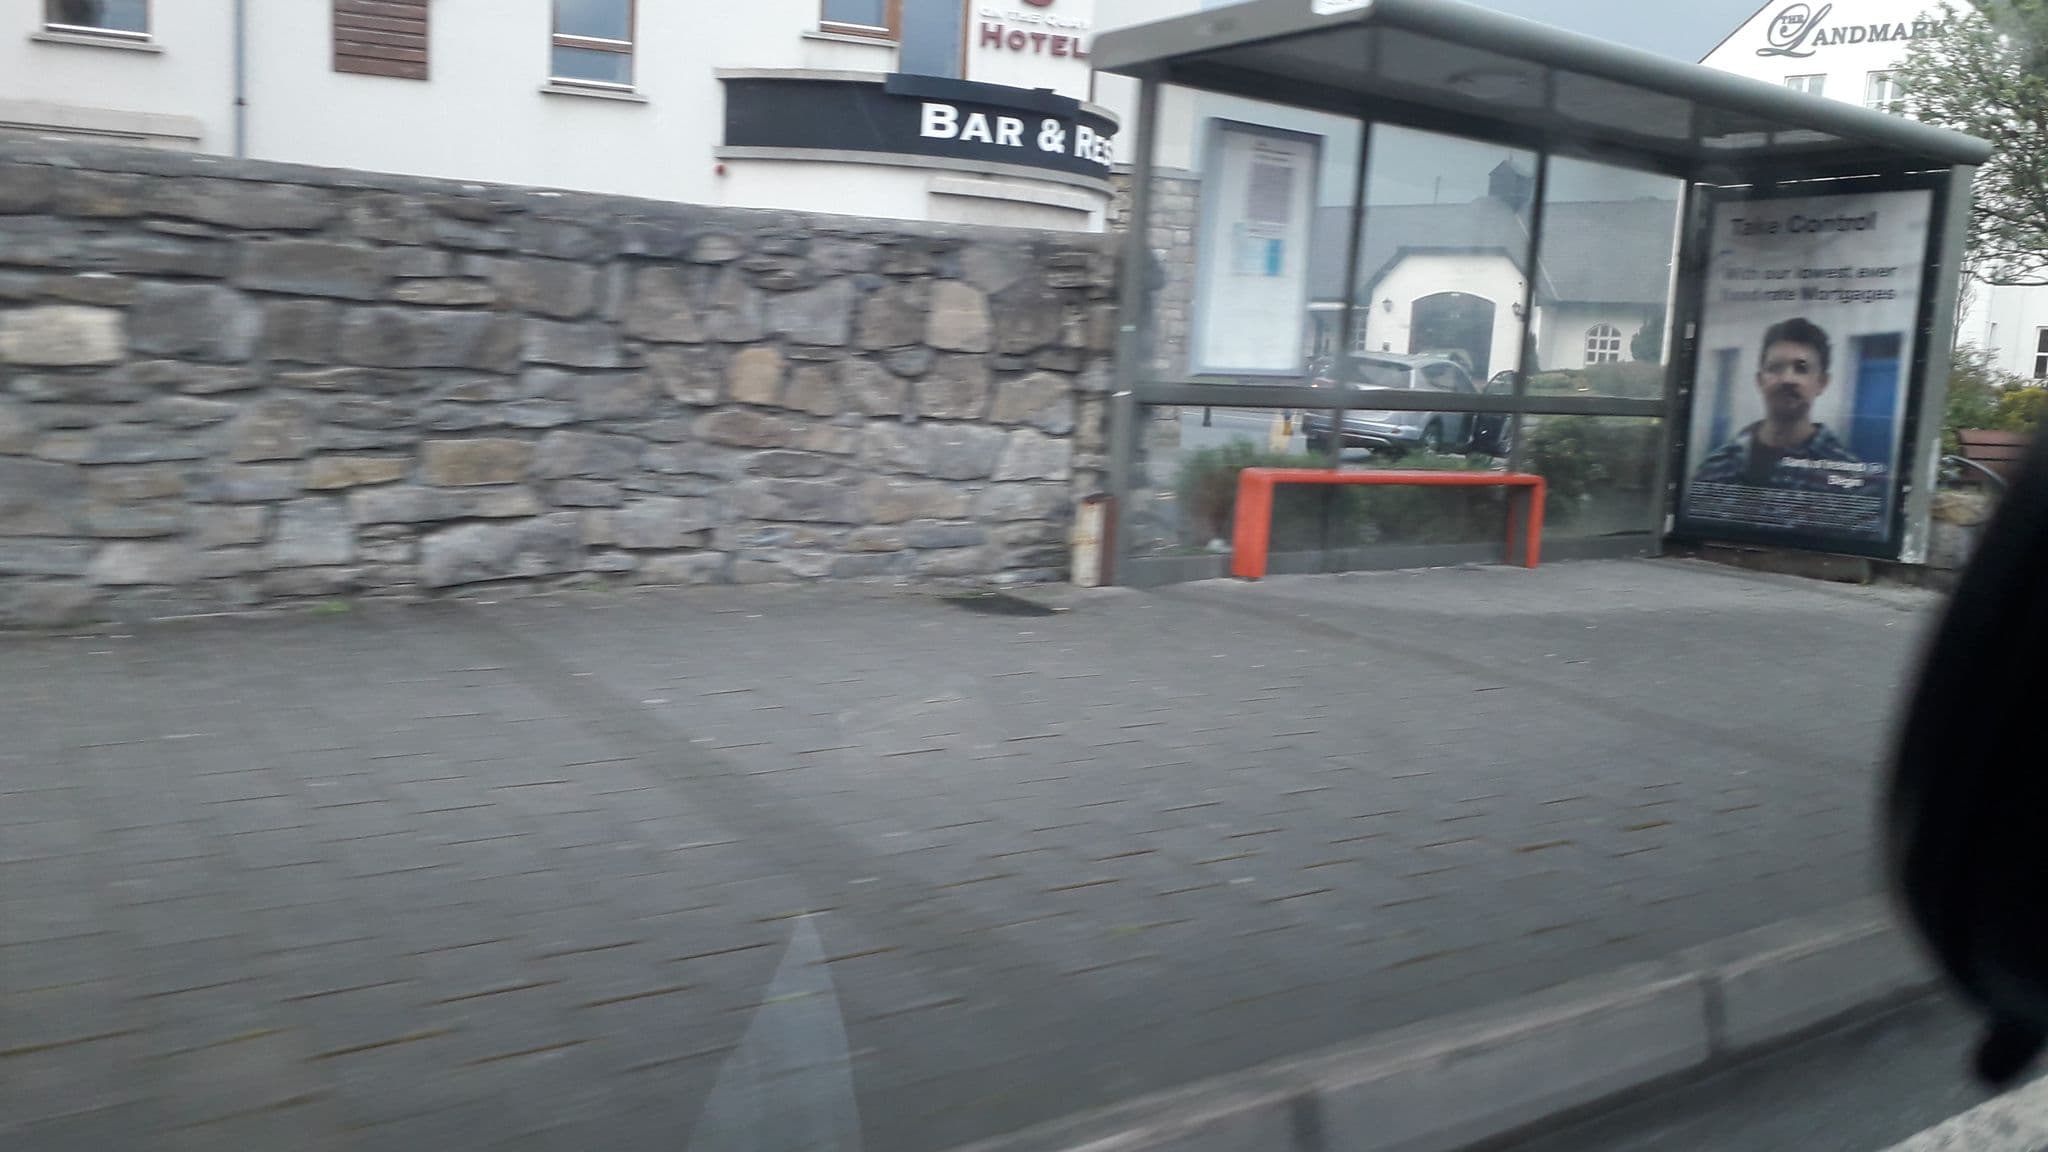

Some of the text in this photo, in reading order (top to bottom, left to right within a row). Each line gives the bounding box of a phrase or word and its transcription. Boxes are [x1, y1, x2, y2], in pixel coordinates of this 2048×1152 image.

[1780, 14, 1806, 25] THE
[980, 22, 1089, 59] HOTEL
[920, 102, 1025, 147] BAR
[1037, 118, 1066, 154] &
[1730, 212, 1877, 237] Take Control
[1801, 287, 1897, 304] Mortgages
